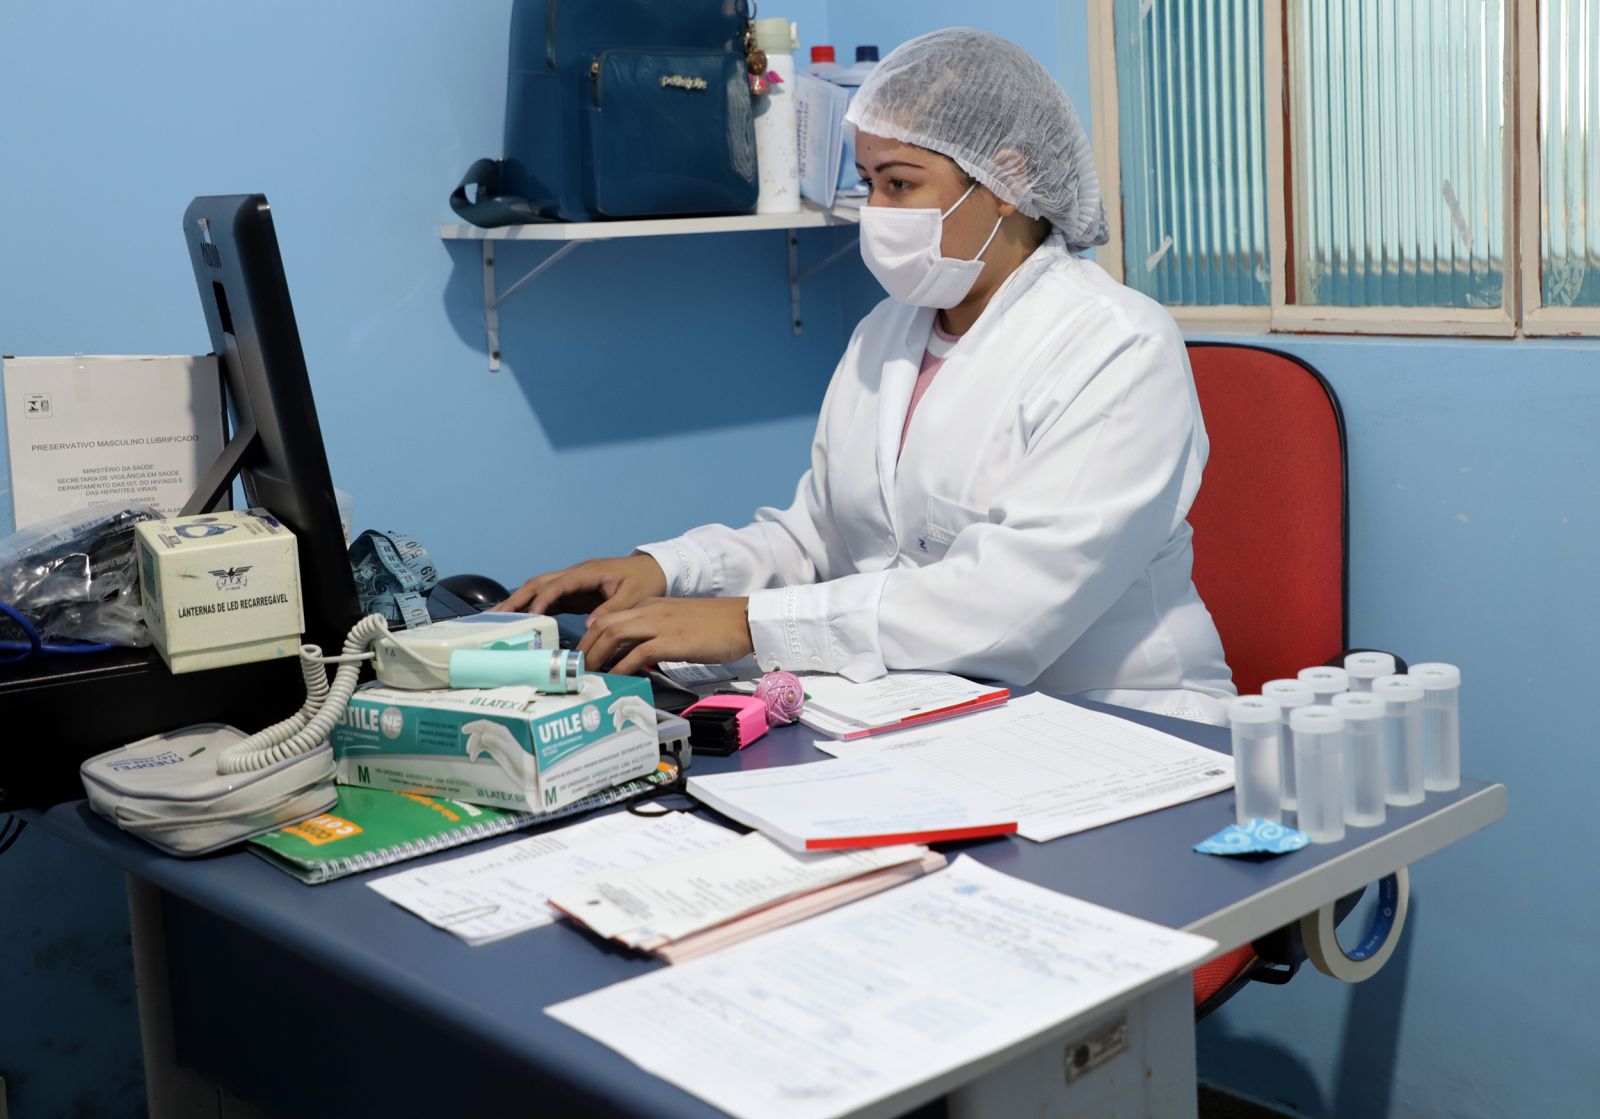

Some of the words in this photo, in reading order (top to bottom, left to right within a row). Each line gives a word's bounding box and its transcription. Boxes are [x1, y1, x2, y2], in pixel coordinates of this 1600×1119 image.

[31, 441, 95, 451] PRESERVATIVO
[97, 438, 145, 447] MASCULINO
[146, 434, 199, 444] LUBRIFICADO
[83, 465, 121, 474] MINISTÉRIO
[132, 463, 154, 471] SAÚDE
[57, 476, 98, 485] SECRETARIA
[110, 472, 146, 481] VIGILÂNCIA
[158, 469, 180, 477] SAÚDE
[57, 482, 111, 492] DEPARTAMENTO
[139, 479, 150, 487] DO
[85, 489, 99, 497] DAS
[100, 486, 136, 495] HEPATITES
[136, 485, 158, 493] VIRAIS
[178, 604, 215, 618] LANTERNAS
[217, 602, 226, 613] DE
[226, 600, 239, 611] LED
[240, 593, 288, 609] RECARREGÁVEL
[480, 697, 516, 709] LATEX
[538, 713, 582, 743] UTILE
[357, 764, 371, 785] M
[485, 788, 513, 801] LATEX
[544, 784, 558, 807] M
